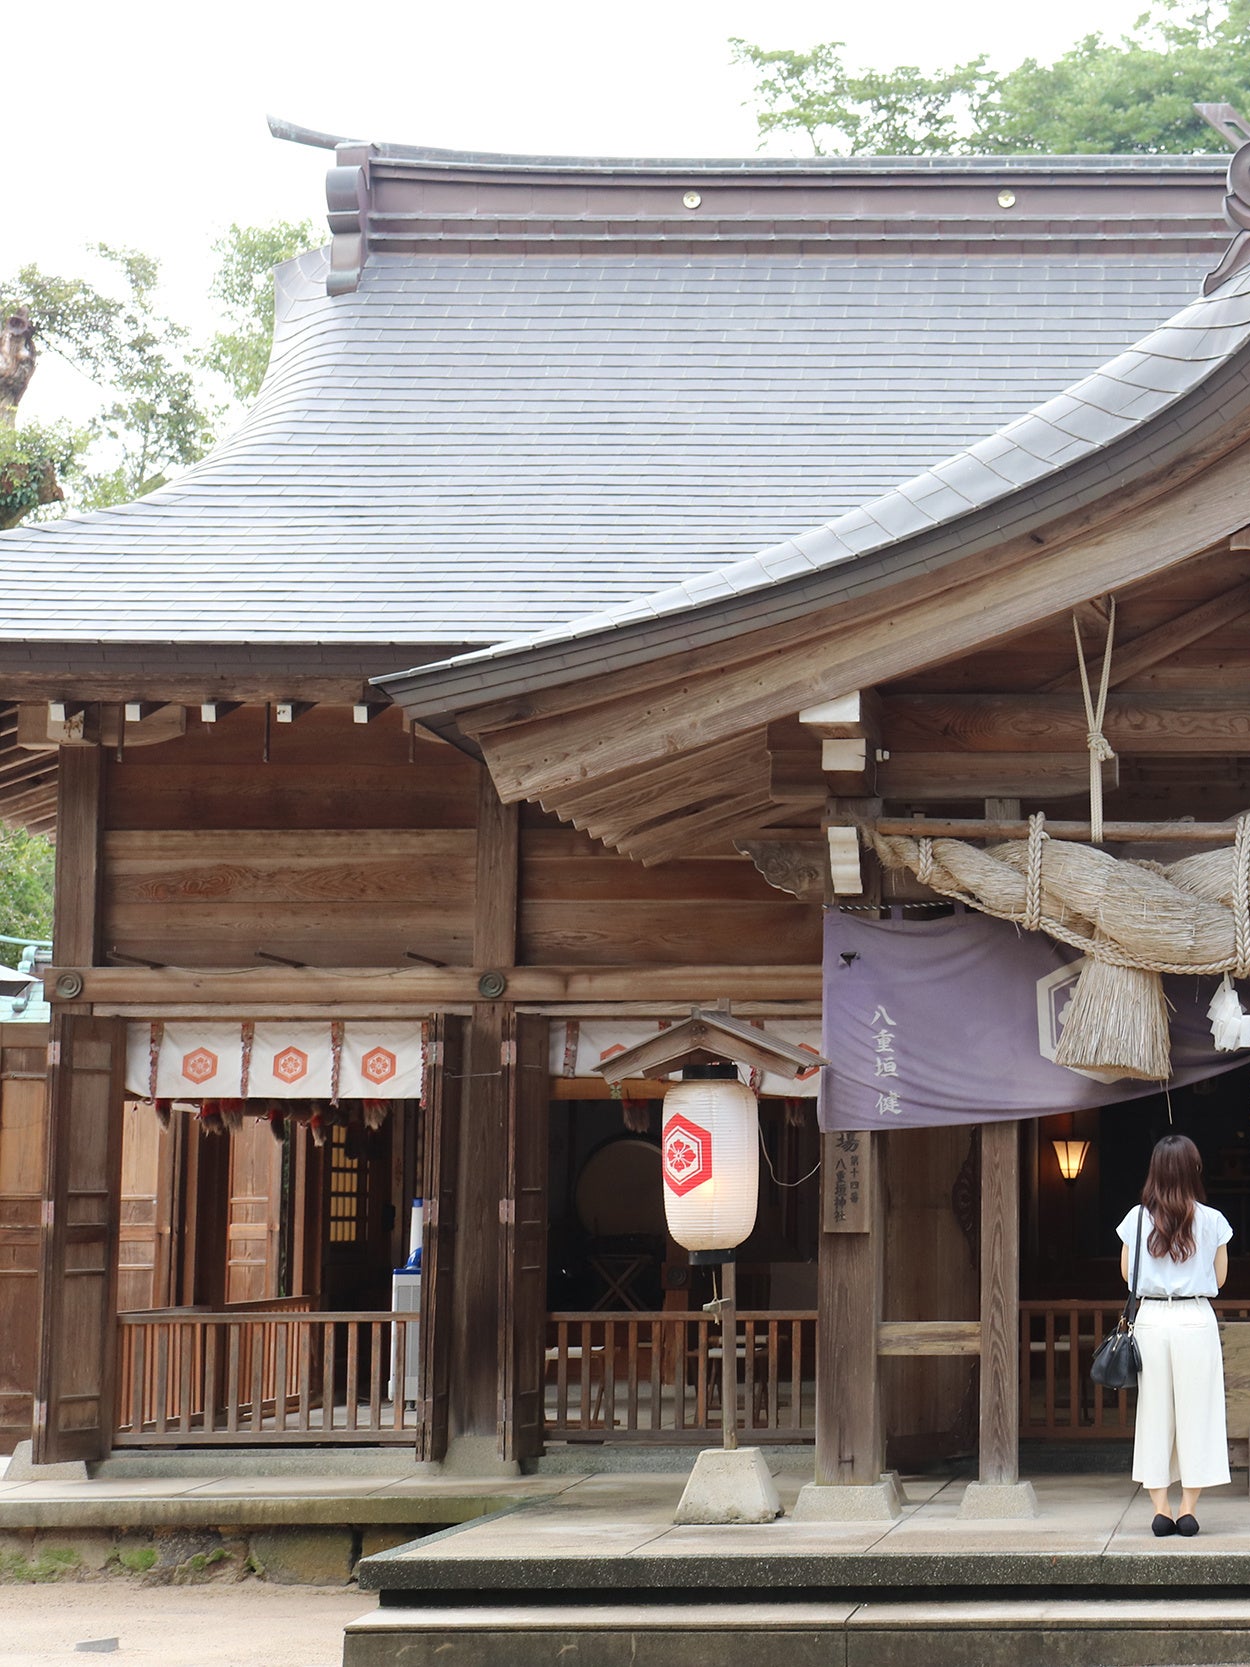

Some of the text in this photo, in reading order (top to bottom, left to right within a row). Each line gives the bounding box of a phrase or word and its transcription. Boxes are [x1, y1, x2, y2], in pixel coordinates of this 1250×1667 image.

[833, 1157, 847, 1223] 八重垣神社
